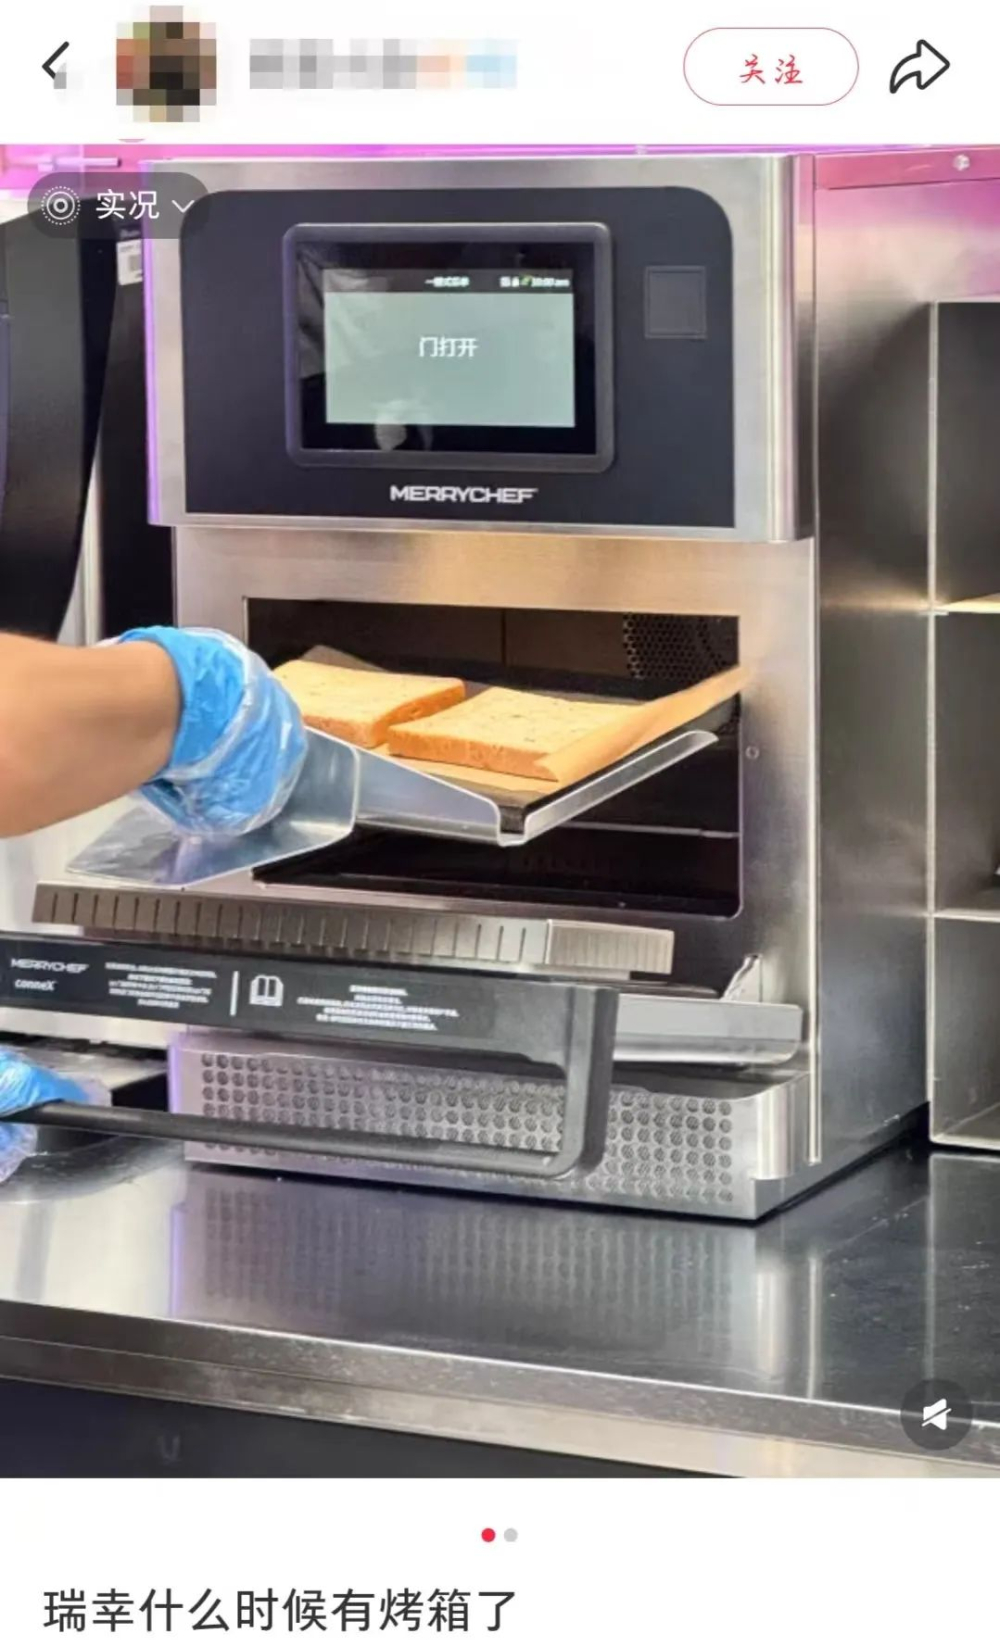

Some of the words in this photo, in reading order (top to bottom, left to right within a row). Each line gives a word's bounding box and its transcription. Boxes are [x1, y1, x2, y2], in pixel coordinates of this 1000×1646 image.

[419, 336, 478, 358] 门打开
[390, 485, 537, 504] MERRYCHEF
[10, 957, 89, 974] MERRYCHEF
